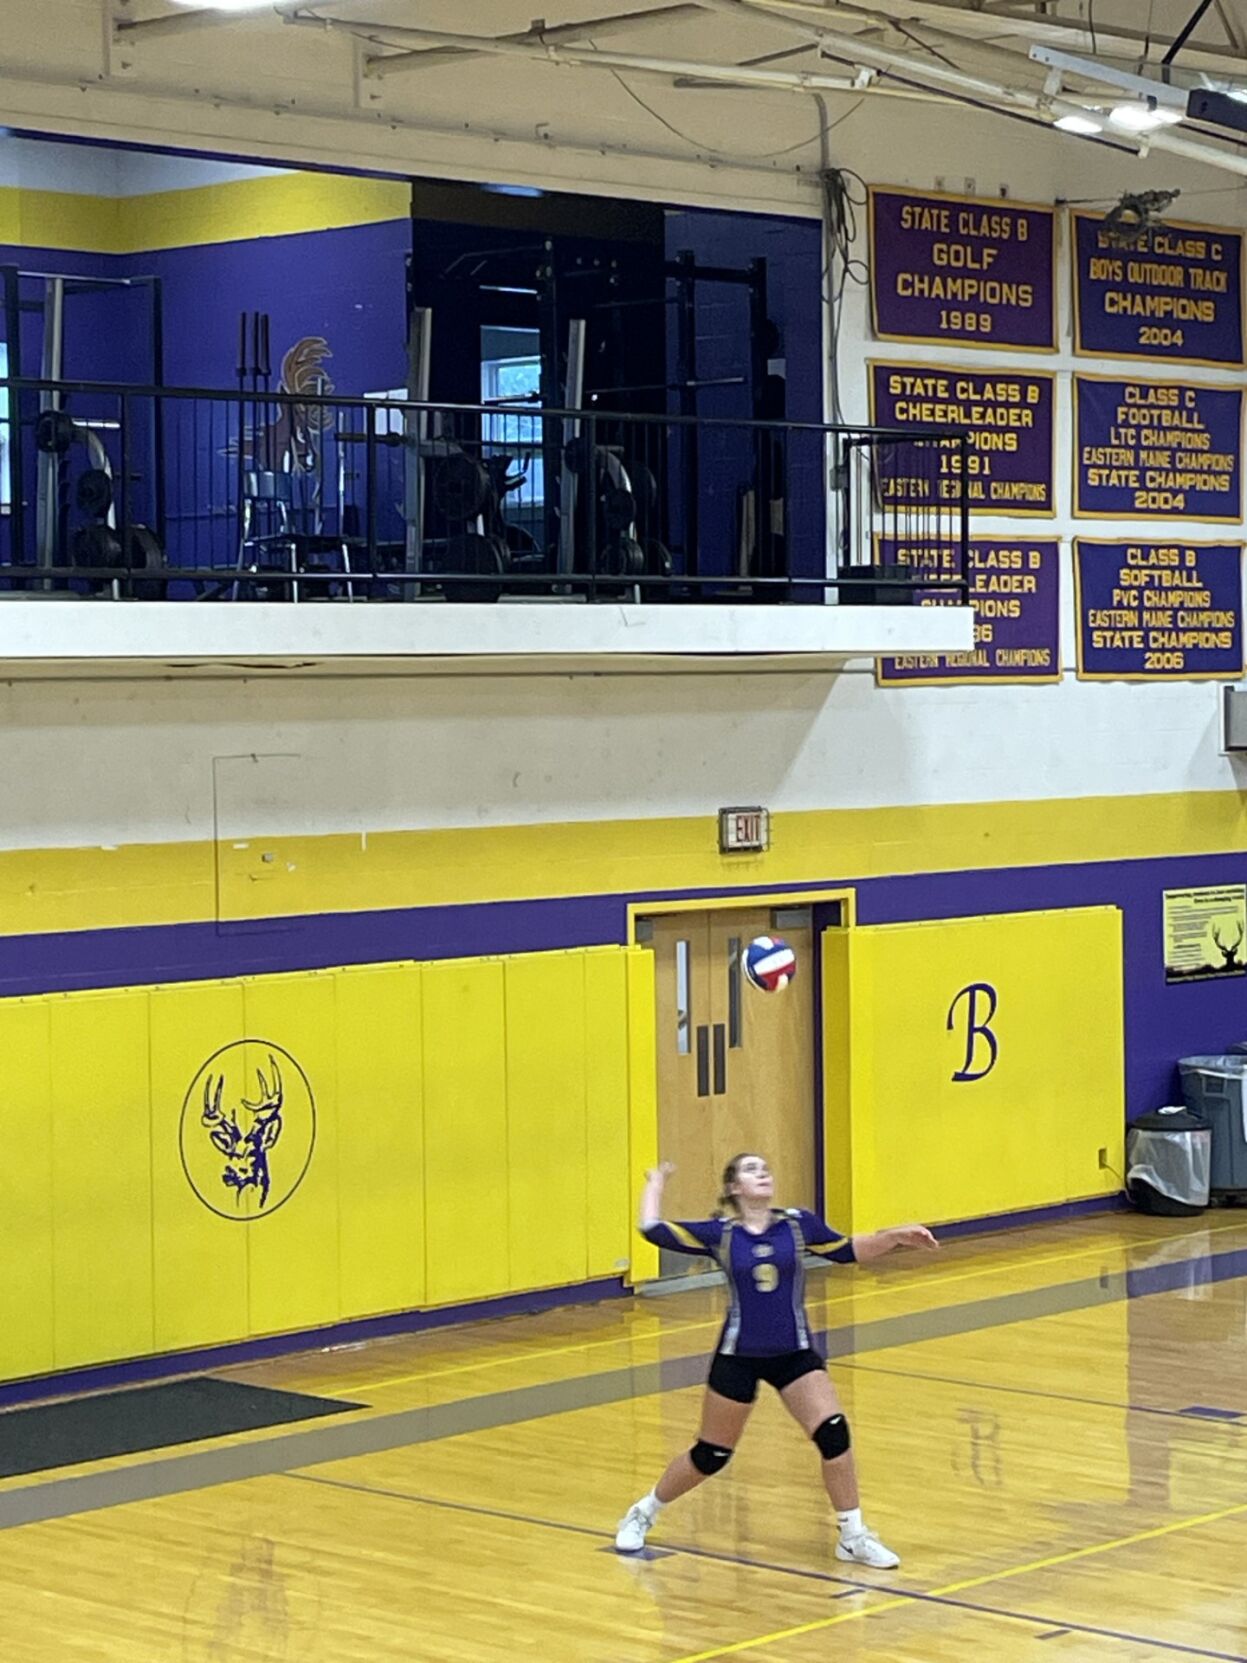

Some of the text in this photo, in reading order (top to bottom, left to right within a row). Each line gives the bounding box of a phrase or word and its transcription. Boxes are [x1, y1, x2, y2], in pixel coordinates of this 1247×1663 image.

[901, 206, 950, 233] STATE
[959, 212, 1011, 240] CLASS
[932, 243, 998, 271] GOLF
[1154, 235, 1206, 259] CLASS
[1211, 243, 1222, 261] C
[1089, 258, 1228, 293] BOYS OUTDOOR TRACK
[897, 272, 1033, 307] CHAMPIONS
[1104, 291, 1216, 322] CHAMPIONS
[940, 310, 992, 332] 1989
[1138, 326, 1184, 346] 2004
[889, 375, 1039, 404] STATE CLASS B
[1124, 386, 1196, 408] CLASS C
[895, 401, 1033, 427] CHEERLEADER
[1117, 406, 1205, 429] FOOTBALL
[1110, 427, 1211, 450] LTC CHAMPIONS
[1083, 447, 1234, 472] EASTERN MAINE CHAMPIONS
[990, 481, 1046, 502] CHAMPIONS
[1087, 468, 1230, 492] STATE CHAMPIONS
[1134, 491, 1185, 510] 2004
[969, 550, 1022, 569] LASS
[1029, 551, 1041, 569] B
[1127, 547, 1196, 567] CLASS B
[1119, 568, 1203, 587] SOFTBALL
[1112, 588, 1211, 608] PVC CHAMPIONS
[1088, 609, 1235, 628] EASTERN MAINE CHAMPIONS
[1092, 630, 1232, 649] STATE CHAMPIONS
[996, 649, 1050, 667] CHAMPIONS
[1144, 652, 1184, 670] 2006
[735, 815, 761, 842] EXIT
[947, 983, 998, 1082] B
